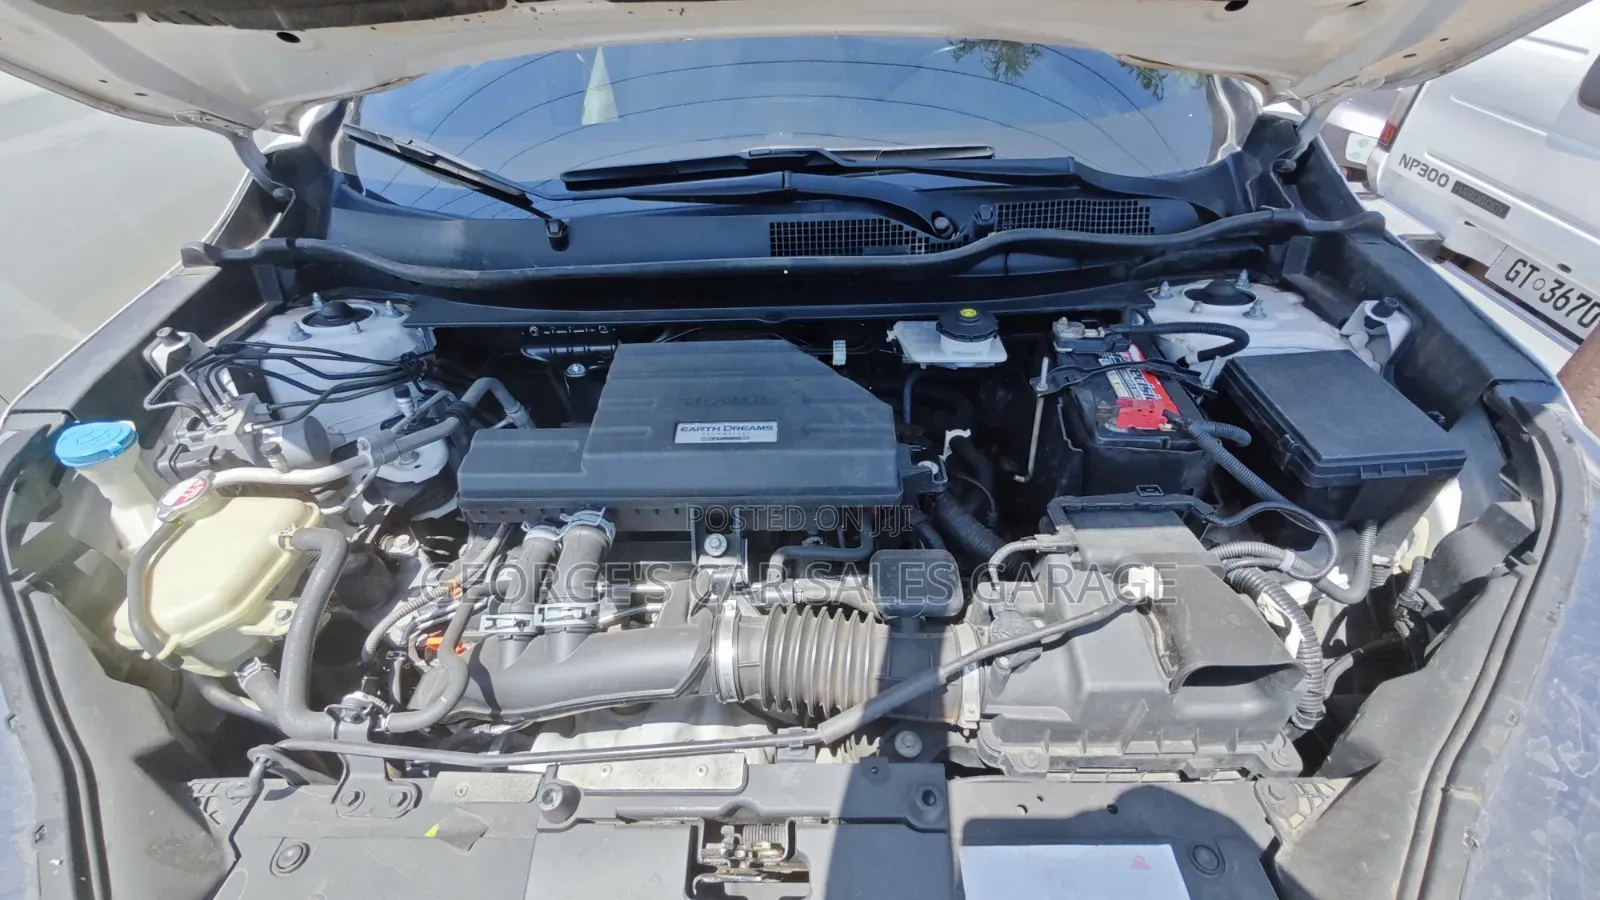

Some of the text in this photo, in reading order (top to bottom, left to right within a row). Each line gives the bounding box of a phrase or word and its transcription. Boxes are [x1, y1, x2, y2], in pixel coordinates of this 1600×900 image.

[1398, 153, 1450, 188] NP300
[1504, 258, 1600, 329] GT 3670
